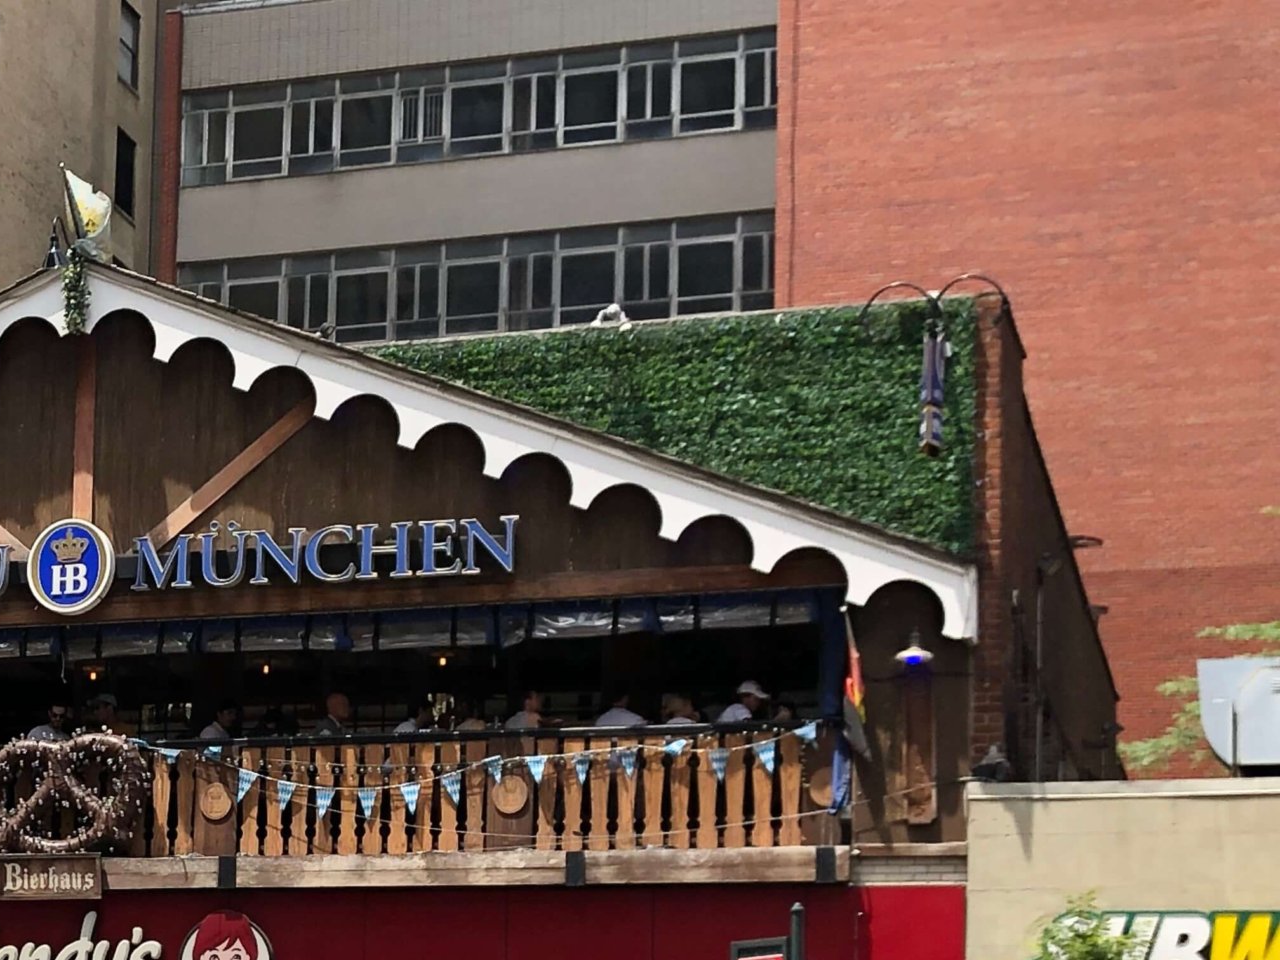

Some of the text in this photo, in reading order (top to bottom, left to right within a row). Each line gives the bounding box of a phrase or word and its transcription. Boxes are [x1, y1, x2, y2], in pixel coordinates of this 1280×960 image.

[131, 514, 520, 592] MÜNCHEN
[51, 564, 88, 597] HB
[3, 861, 95, 893] Bierhaus
